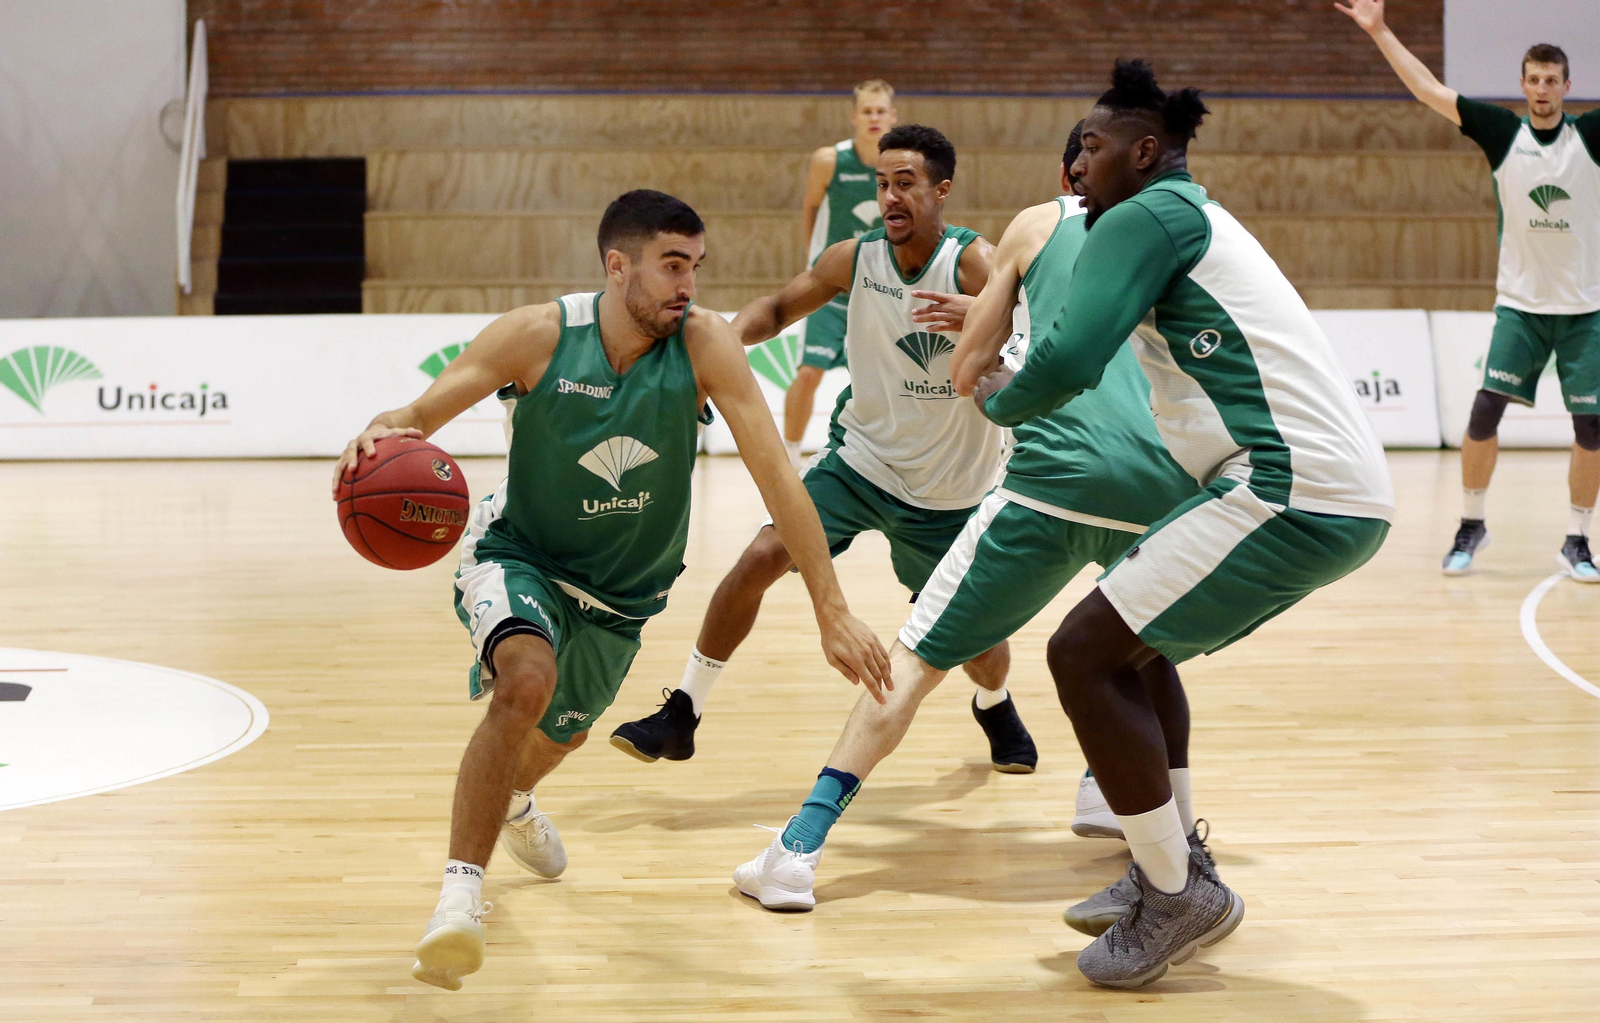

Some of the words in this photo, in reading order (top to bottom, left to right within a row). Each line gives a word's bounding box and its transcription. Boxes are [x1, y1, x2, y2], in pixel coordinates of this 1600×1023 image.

[1529, 219, 1570, 232] Unicaja
[862, 276, 904, 300] SPALDING
[557, 378, 614, 399] SPALDING
[904, 379, 957, 397] Unicaj
[98, 383, 228, 416] Unicaja
